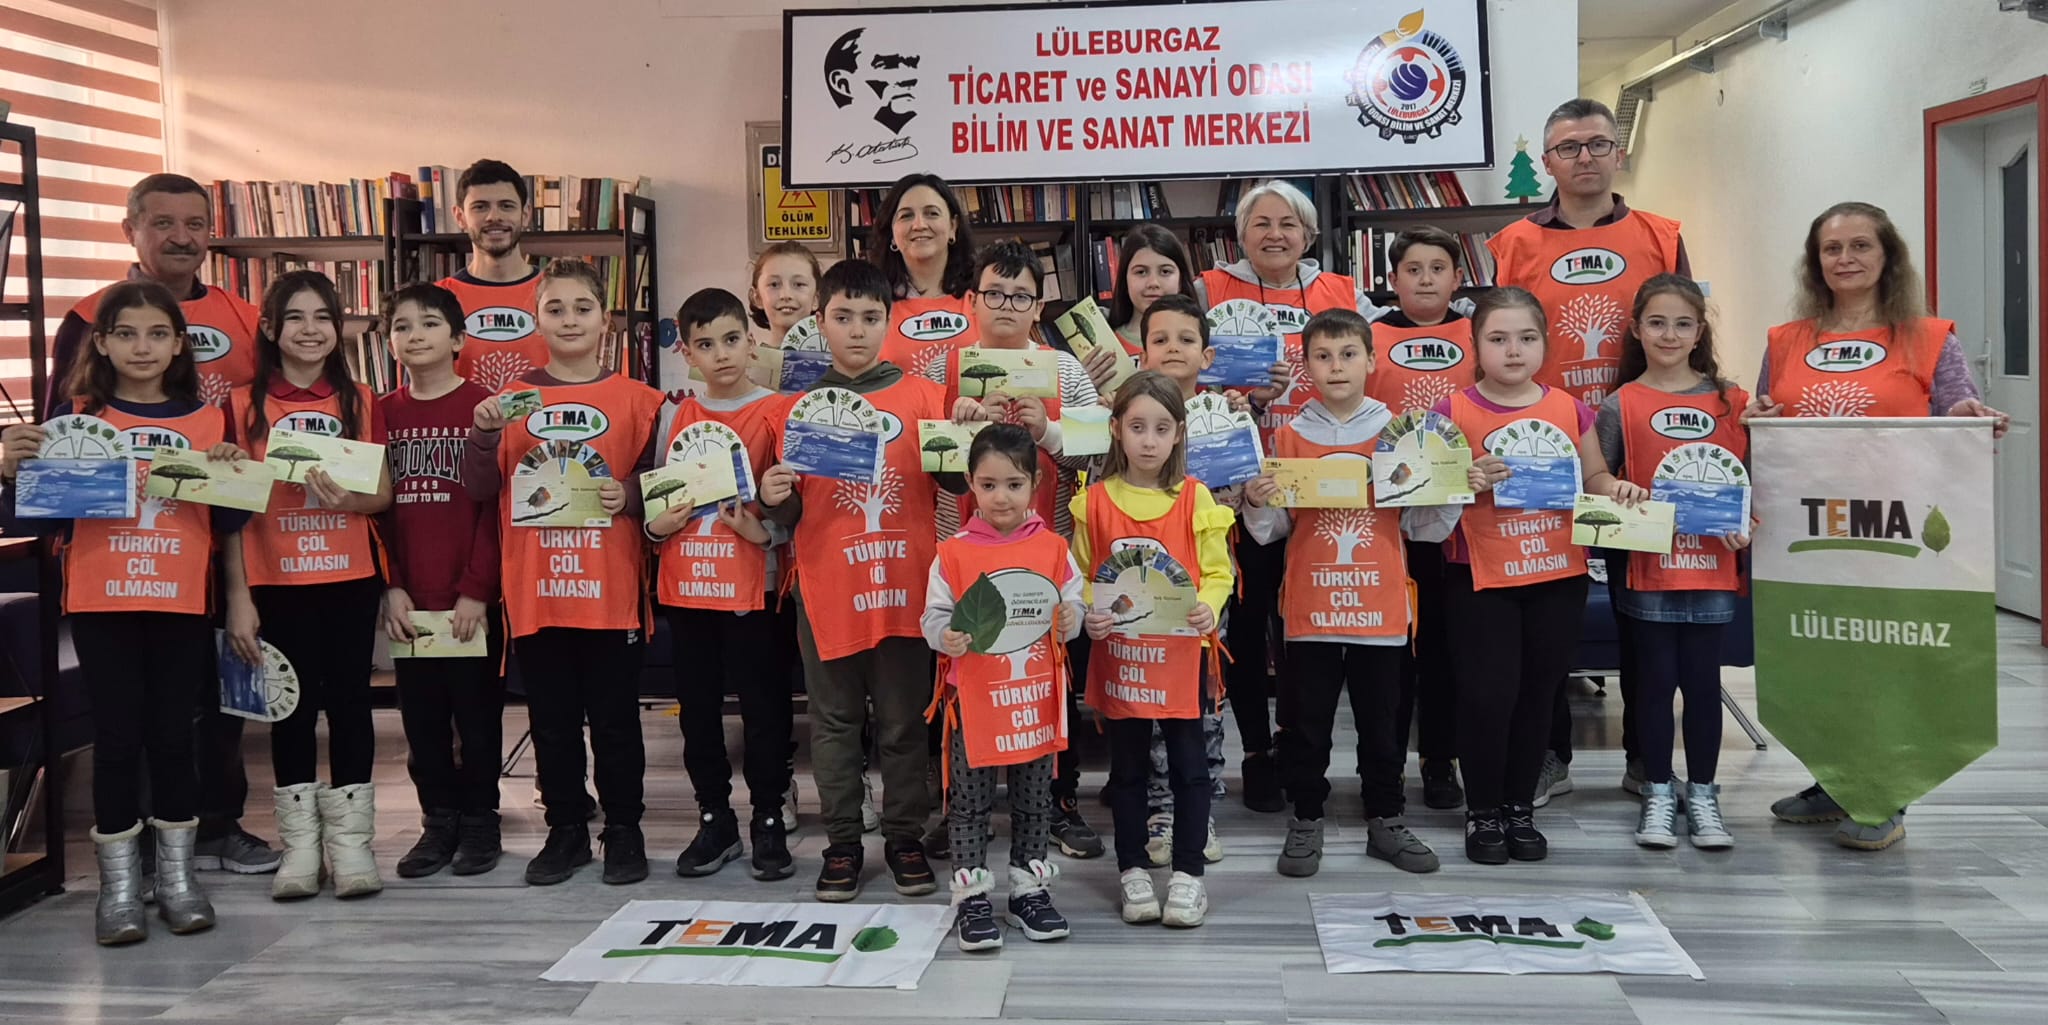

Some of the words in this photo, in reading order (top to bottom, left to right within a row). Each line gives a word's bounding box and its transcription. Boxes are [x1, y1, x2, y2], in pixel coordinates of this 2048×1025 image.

[1036, 26, 1220, 57] LÜLEBURGAZ
[948, 65, 1067, 104] TİCARET
[1076, 78, 1106, 102] ve
[1115, 58, 1218, 99] SANAYİ
[1228, 61, 1313, 96] ODASI
[952, 112, 1028, 154] BİLİM
[1037, 118, 1073, 151] VE
[1083, 116, 1174, 150] SANAT
[1184, 103, 1310, 146] MERKEZİ
[782, 210, 814, 223] ÖLÜM
[768, 224, 828, 236] TEHLİKESİ
[1565, 255, 1603, 272] TEMA
[477, 313, 516, 329] TEMA
[914, 316, 952, 331] TEMA
[1403, 344, 1445, 360] TEMA
[1822, 346, 1862, 361] TEMA
[1561, 363, 1618, 387] TÜRKİY
[289, 418, 326, 432] TEMA
[543, 411, 587, 425] TEMA
[1664, 412, 1700, 428] TEMA
[130, 432, 172, 447] TEMA
[388, 427, 471, 440] LEGENDARY
[405, 480, 438, 491] 1849
[420, 493, 431, 502] TO
[432, 492, 450, 502] WIN
[277, 511, 347, 533] TÜRKİYE
[1497, 515, 1563, 538] TÜRKİYE
[1801, 498, 1912, 540] TEMA
[107, 531, 181, 555] TÜRKİYE
[297, 532, 329, 556] ÇÖL
[680, 538, 735, 558] TÜRKİYE
[1521, 536, 1550, 559] ÇÖL
[126, 554, 159, 579] ÇÖL
[280, 554, 349, 573] OLMASIN
[550, 551, 584, 578] ÇÖL
[691, 560, 718, 578] ÇÖL
[1504, 553, 1569, 577] OLMASIN
[1659, 554, 1718, 571] OLMASIN
[1311, 567, 1380, 587] TÜRKİYE
[105, 579, 178, 599] OLMASIN
[679, 582, 736, 598] OLMASIN
[1330, 588, 1363, 611] ÇÖL
[1012, 607, 1035, 616] TEMA
[1310, 611, 1383, 627] OLMASIN
[1790, 610, 1951, 648] LÜLEBURGAZ
[1106, 638, 1167, 664] TÜRKİYE
[1119, 663, 1147, 684] ÇÖL
[989, 680, 1052, 708] TÜRKİYE
[1105, 680, 1167, 706] OLMASIN
[1011, 705, 1040, 731] ÇÖL
[995, 724, 1056, 753] OLMASIN
[639, 918, 838, 950] TEMA
[1373, 912, 1564, 938] TEMA
